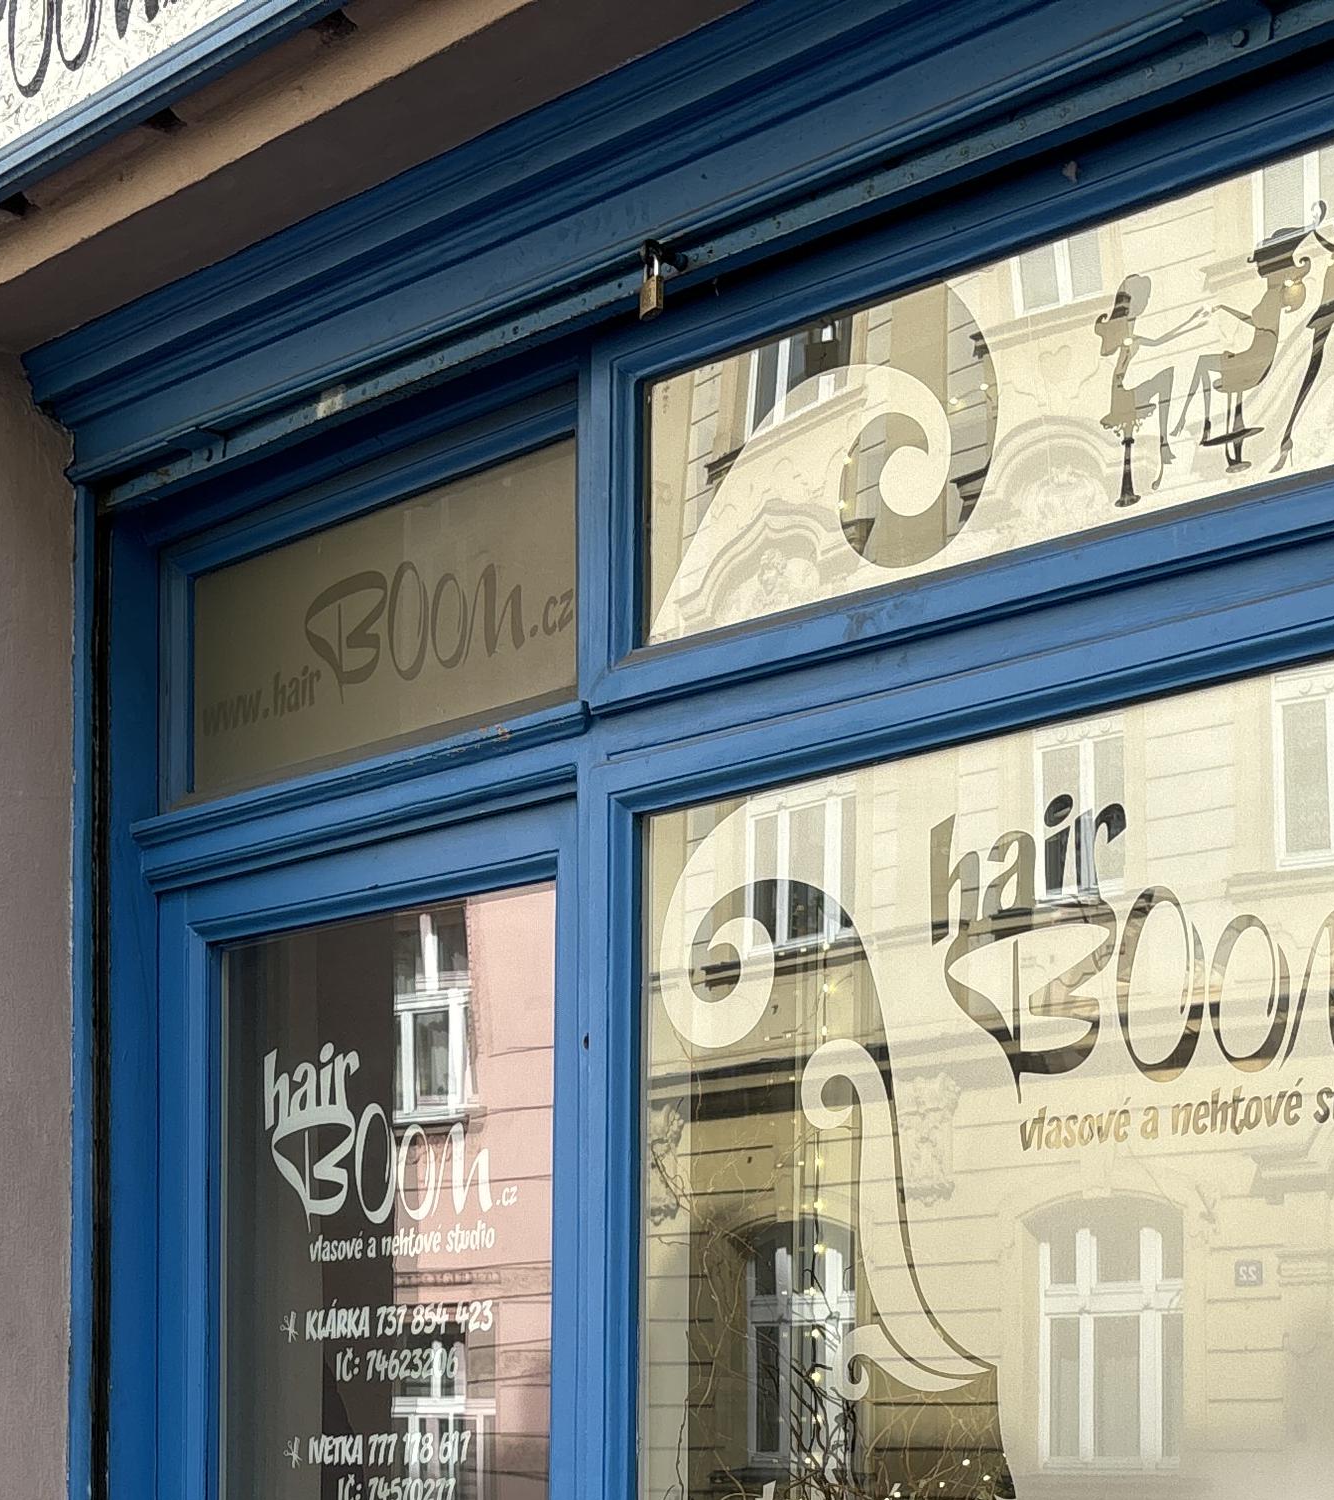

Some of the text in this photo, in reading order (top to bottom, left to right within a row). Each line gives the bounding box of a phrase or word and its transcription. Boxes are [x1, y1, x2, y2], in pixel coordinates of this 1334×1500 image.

[930, 793, 1127, 946] hair
[263, 1042, 360, 1131] hair
[1019, 1096, 1132, 1151] vlasové
[1140, 1106, 1159, 1141] a
[1171, 1077, 1304, 1137] nehtové
[309, 1220, 495, 1262] vlasové a nehtové studio
[305, 1299, 493, 1342] KLÁRKA 737 854 423
[336, 1347, 460, 1382] IČ: 74623206
[308, 1433, 363, 1466] IVETKA
[368, 1433, 398, 1467] 777
[438, 1430, 472, 1465] 617
